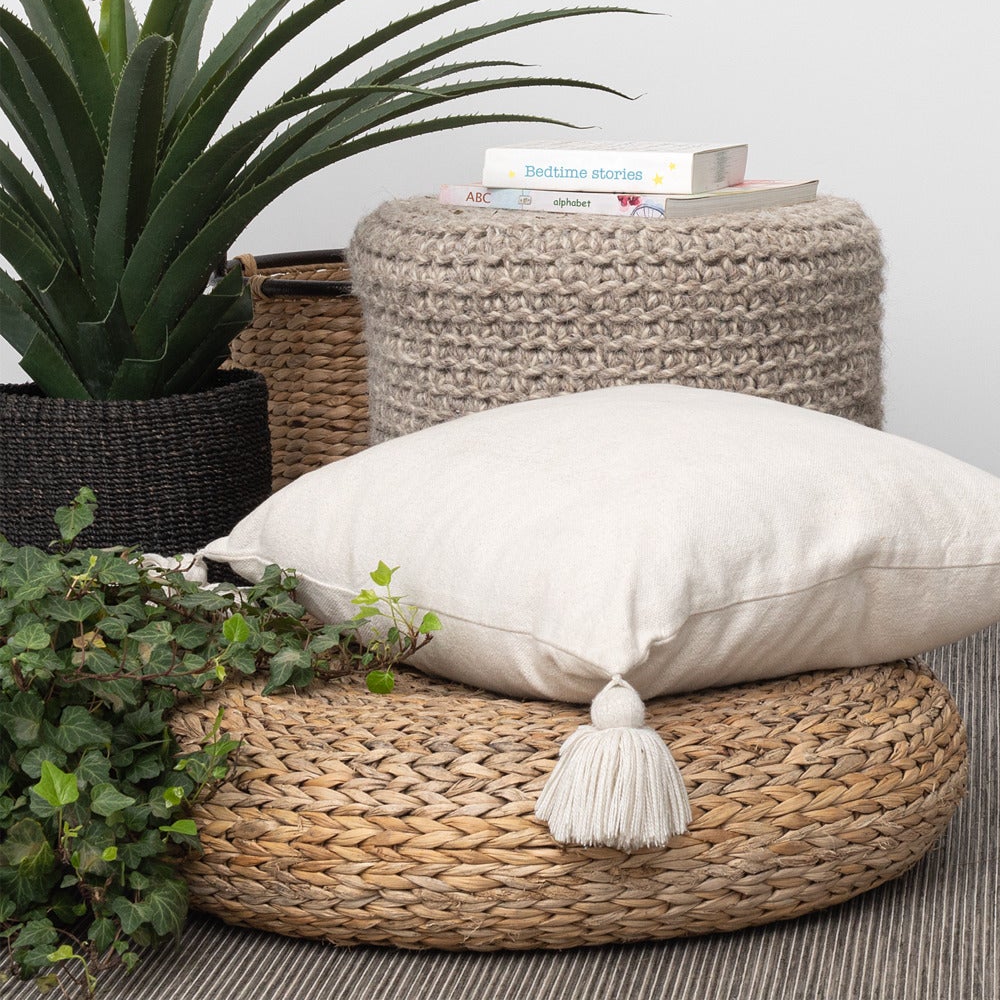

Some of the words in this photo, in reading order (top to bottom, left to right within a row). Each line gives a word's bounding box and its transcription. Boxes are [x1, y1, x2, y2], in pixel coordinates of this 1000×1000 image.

[524, 165, 587, 179] Bedtime
[591, 168, 643, 181] stories
[465, 191, 491, 204] ABC
[553, 198, 591, 209] alphabet
